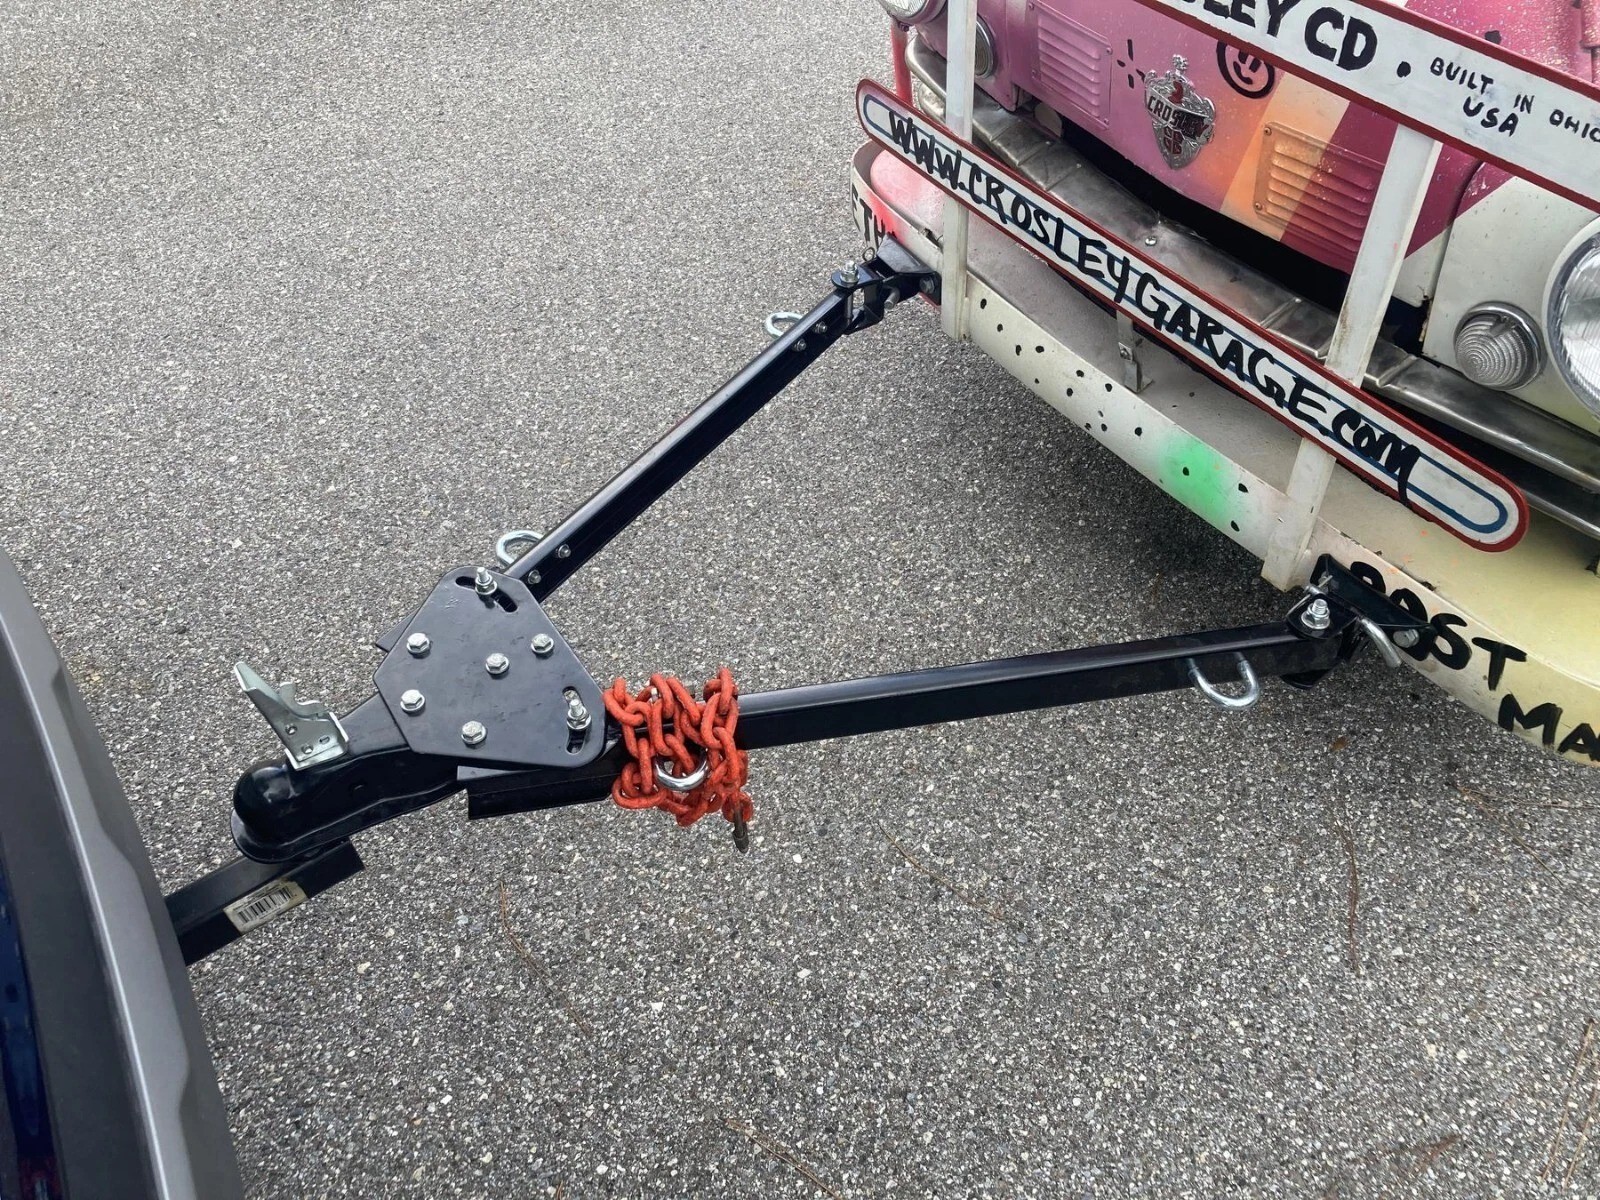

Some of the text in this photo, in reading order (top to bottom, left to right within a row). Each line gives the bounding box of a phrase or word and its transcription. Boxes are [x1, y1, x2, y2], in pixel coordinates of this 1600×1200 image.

[1304, 7, 1378, 71] CD
[1430, 57, 1494, 94] BUILT
[1514, 94, 1535, 114] IN
[1463, 96, 1519, 137] USA
[1498, 693, 1600, 762] MA
